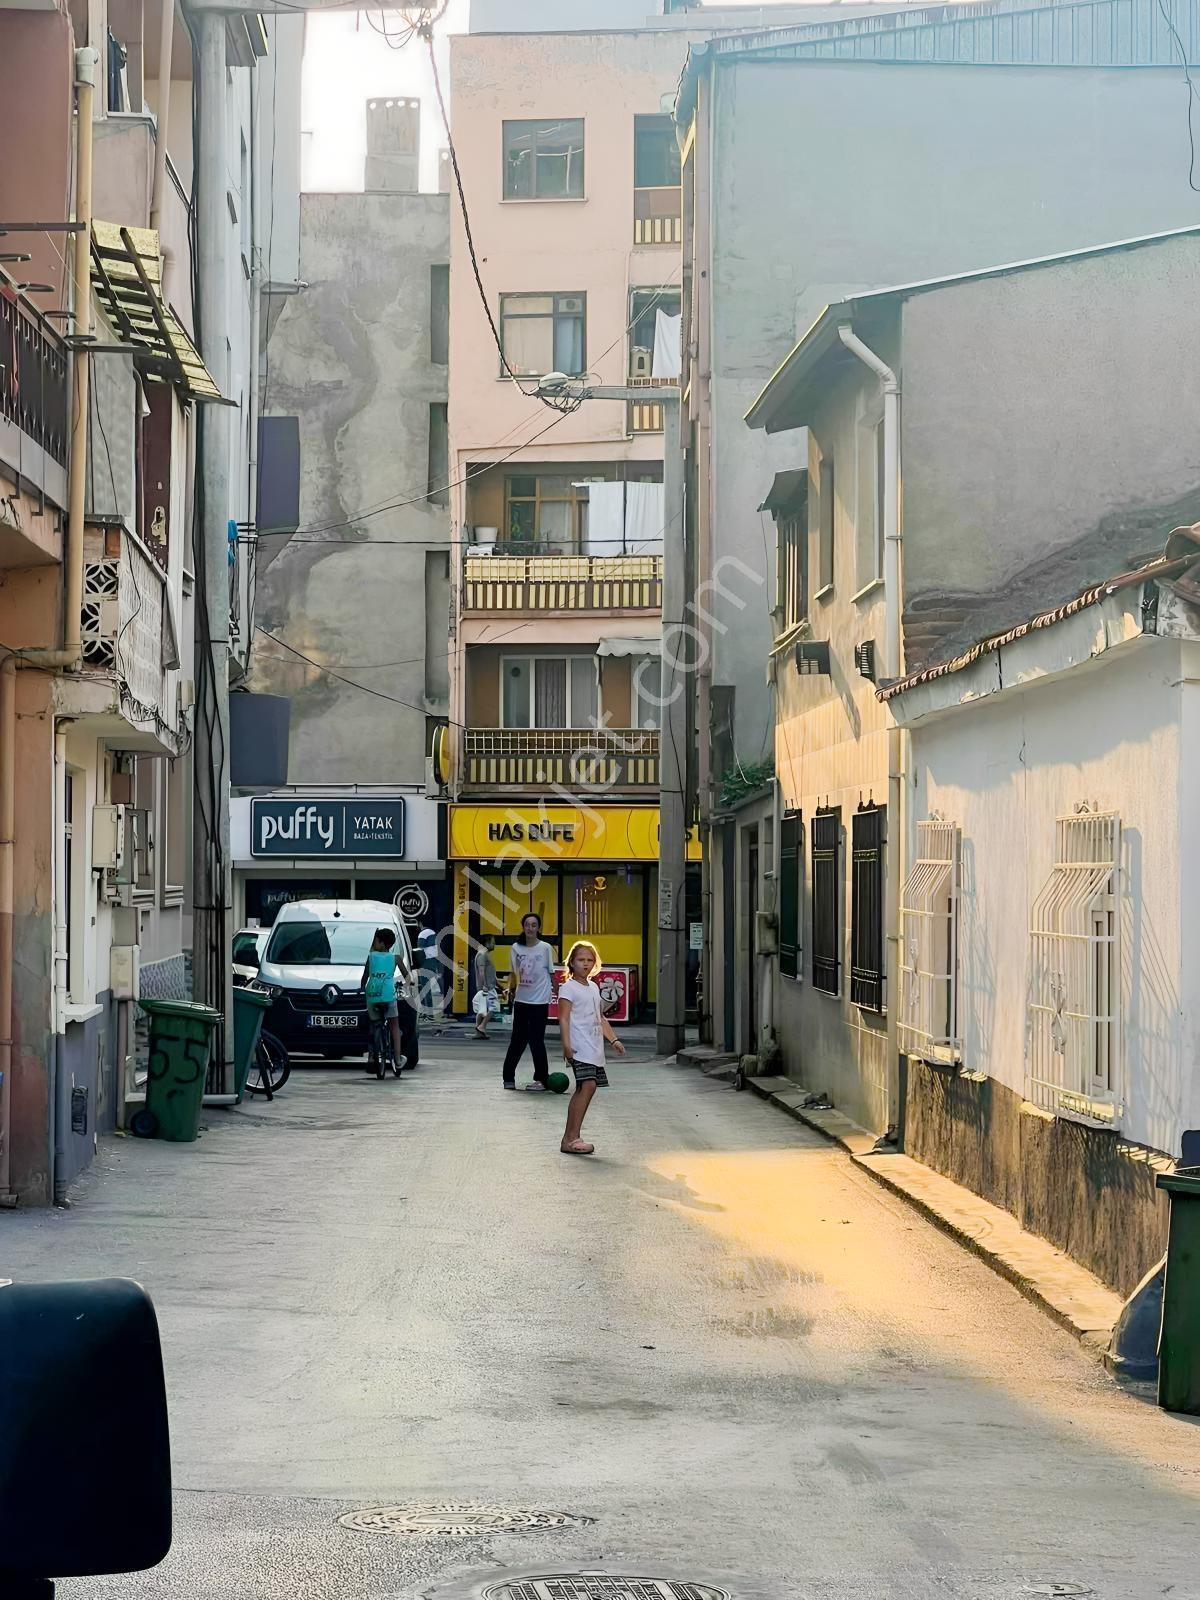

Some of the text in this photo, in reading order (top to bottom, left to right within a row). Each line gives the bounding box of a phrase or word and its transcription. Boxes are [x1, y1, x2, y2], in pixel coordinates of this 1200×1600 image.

[261, 806, 334, 849] puffy
[354, 816, 393, 829] YATAK
[488, 823, 524, 841] HAS
[312, 1016, 321, 1025] 16
